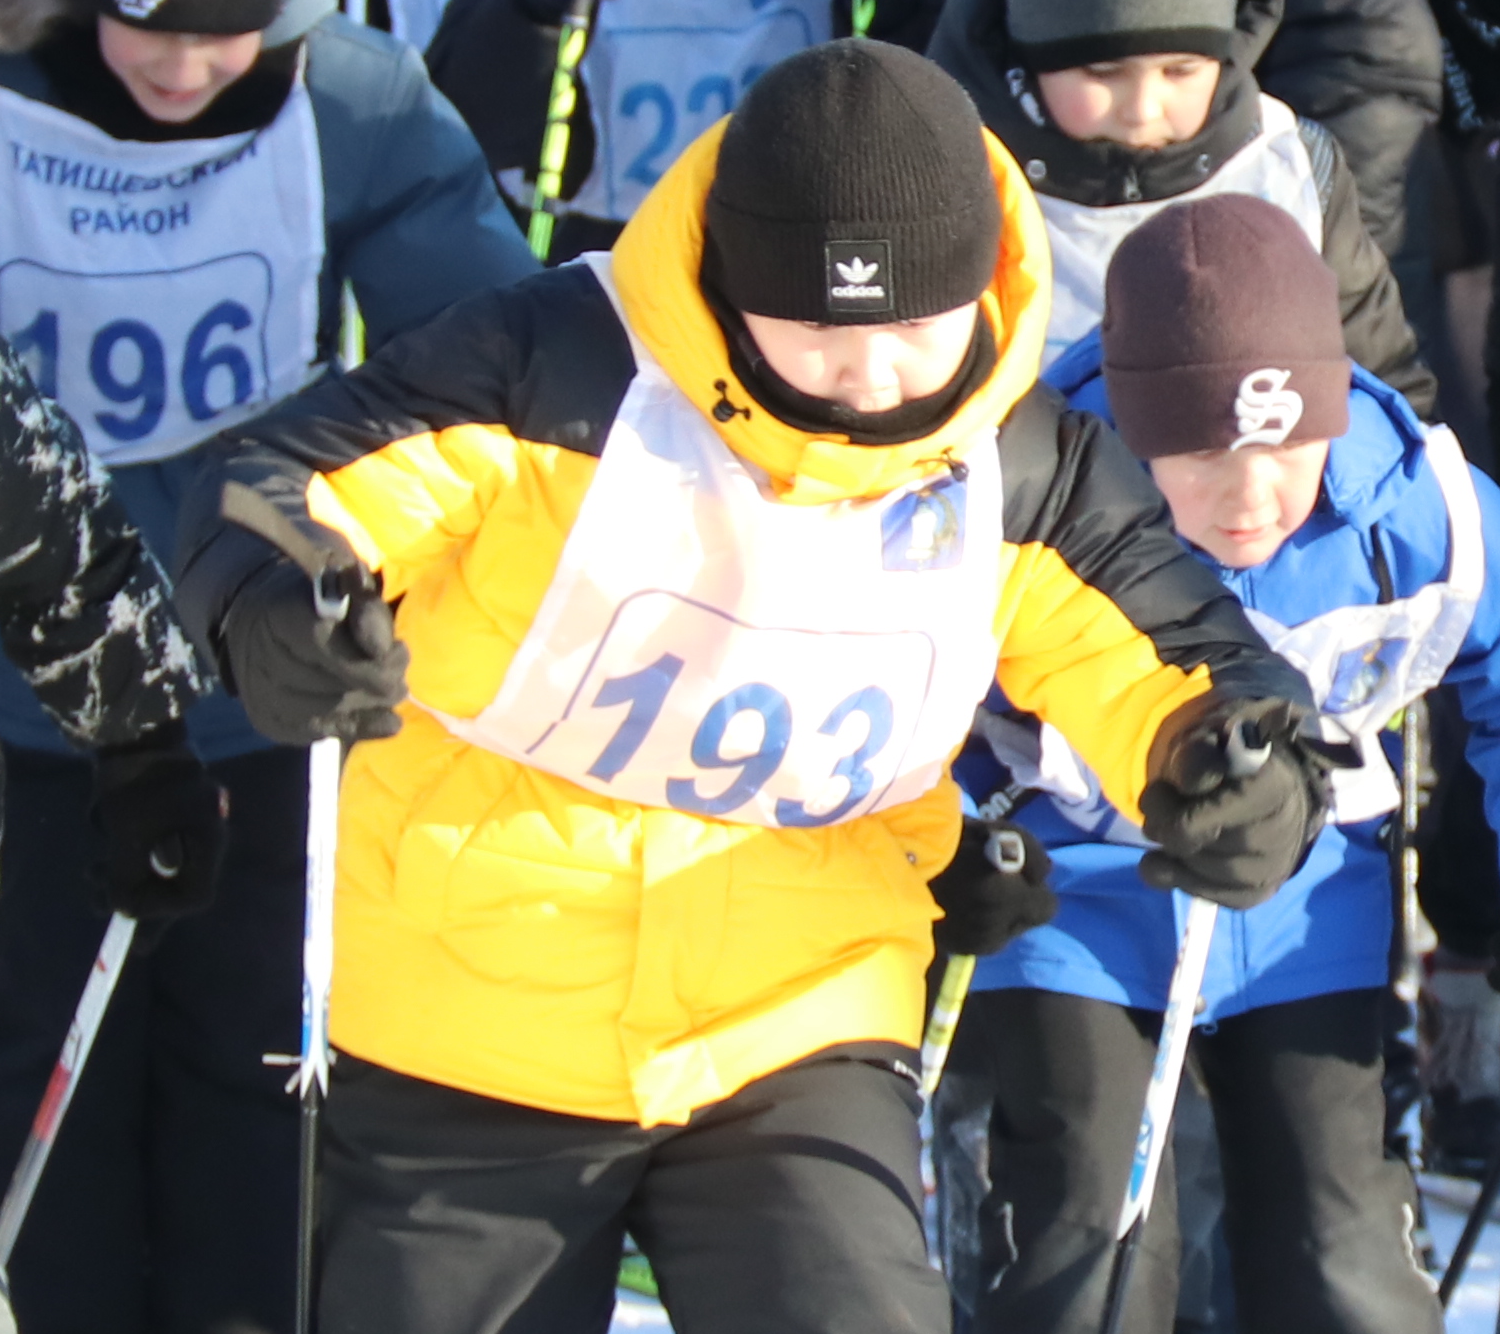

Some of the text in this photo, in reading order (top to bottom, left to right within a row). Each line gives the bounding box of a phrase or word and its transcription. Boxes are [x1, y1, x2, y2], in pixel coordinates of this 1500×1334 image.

[70, 201, 192, 236] РАЙОН
[8, 299, 253, 441] 196
[1230, 368, 1304, 451] S
[586, 652, 894, 828] 193
